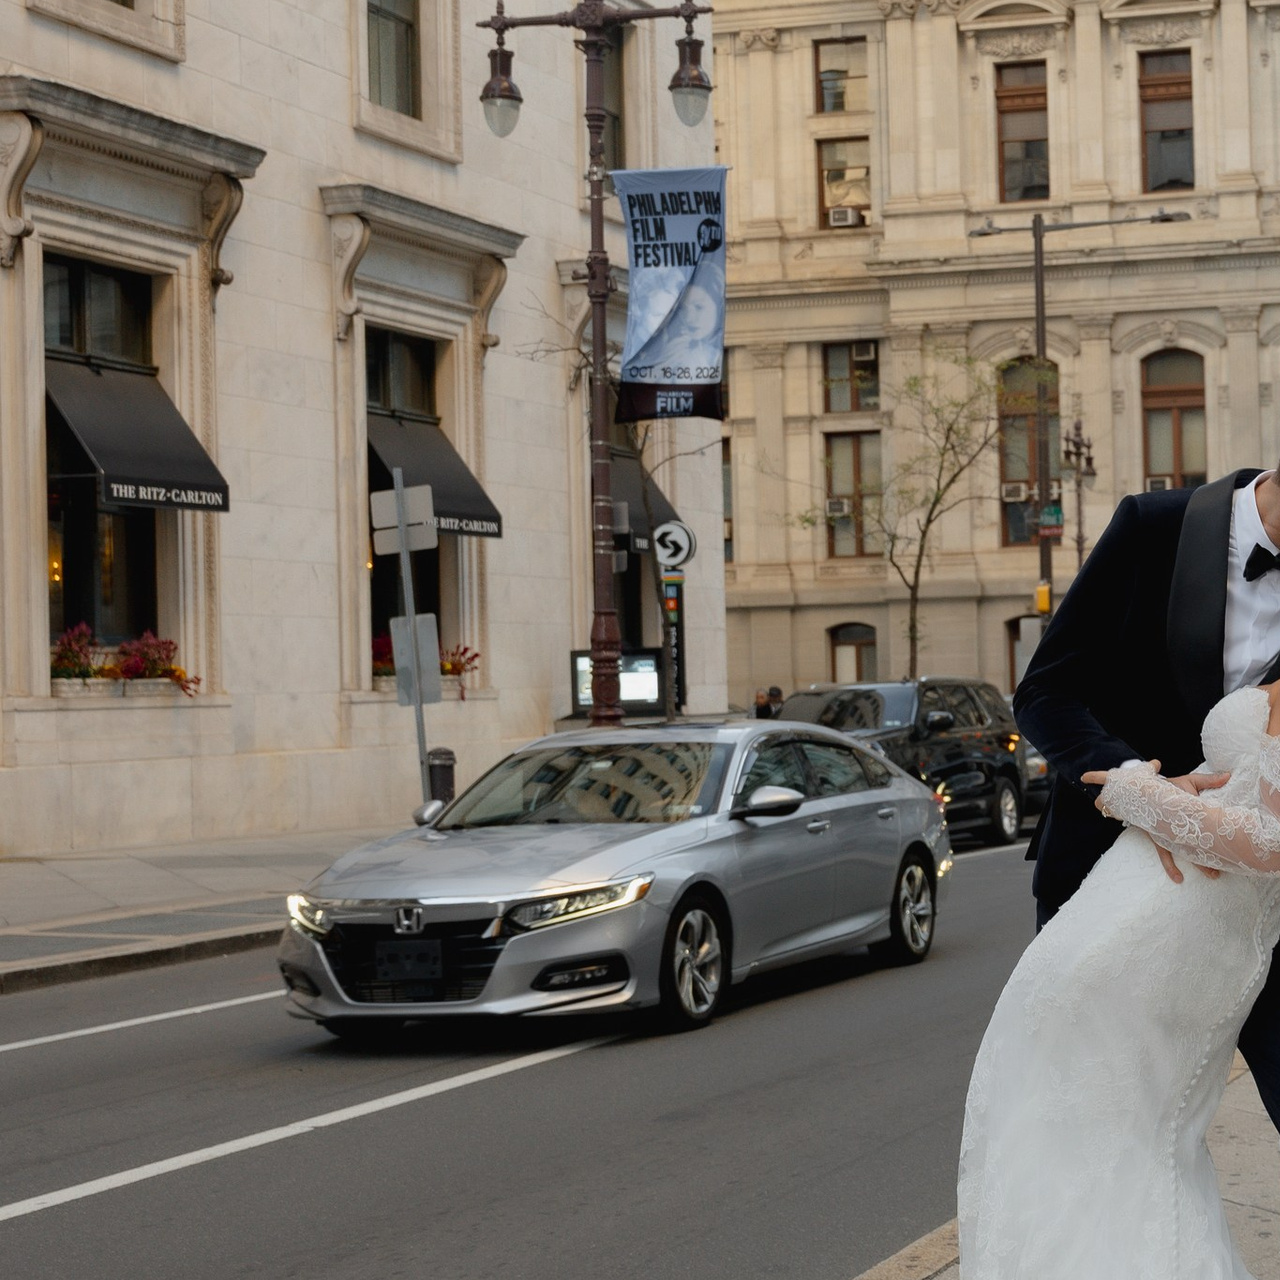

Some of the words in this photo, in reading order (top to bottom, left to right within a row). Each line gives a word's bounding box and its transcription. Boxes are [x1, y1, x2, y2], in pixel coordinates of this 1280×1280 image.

[631, 217, 667, 242] FILM
[634, 241, 698, 268] FESTIVAL
[629, 366, 657, 379] OCT.
[662, 366, 693, 381] 16-26,
[656, 397, 694, 413] FILM
[111, 483, 136, 499] THE
[635, 537, 649, 550] THE
